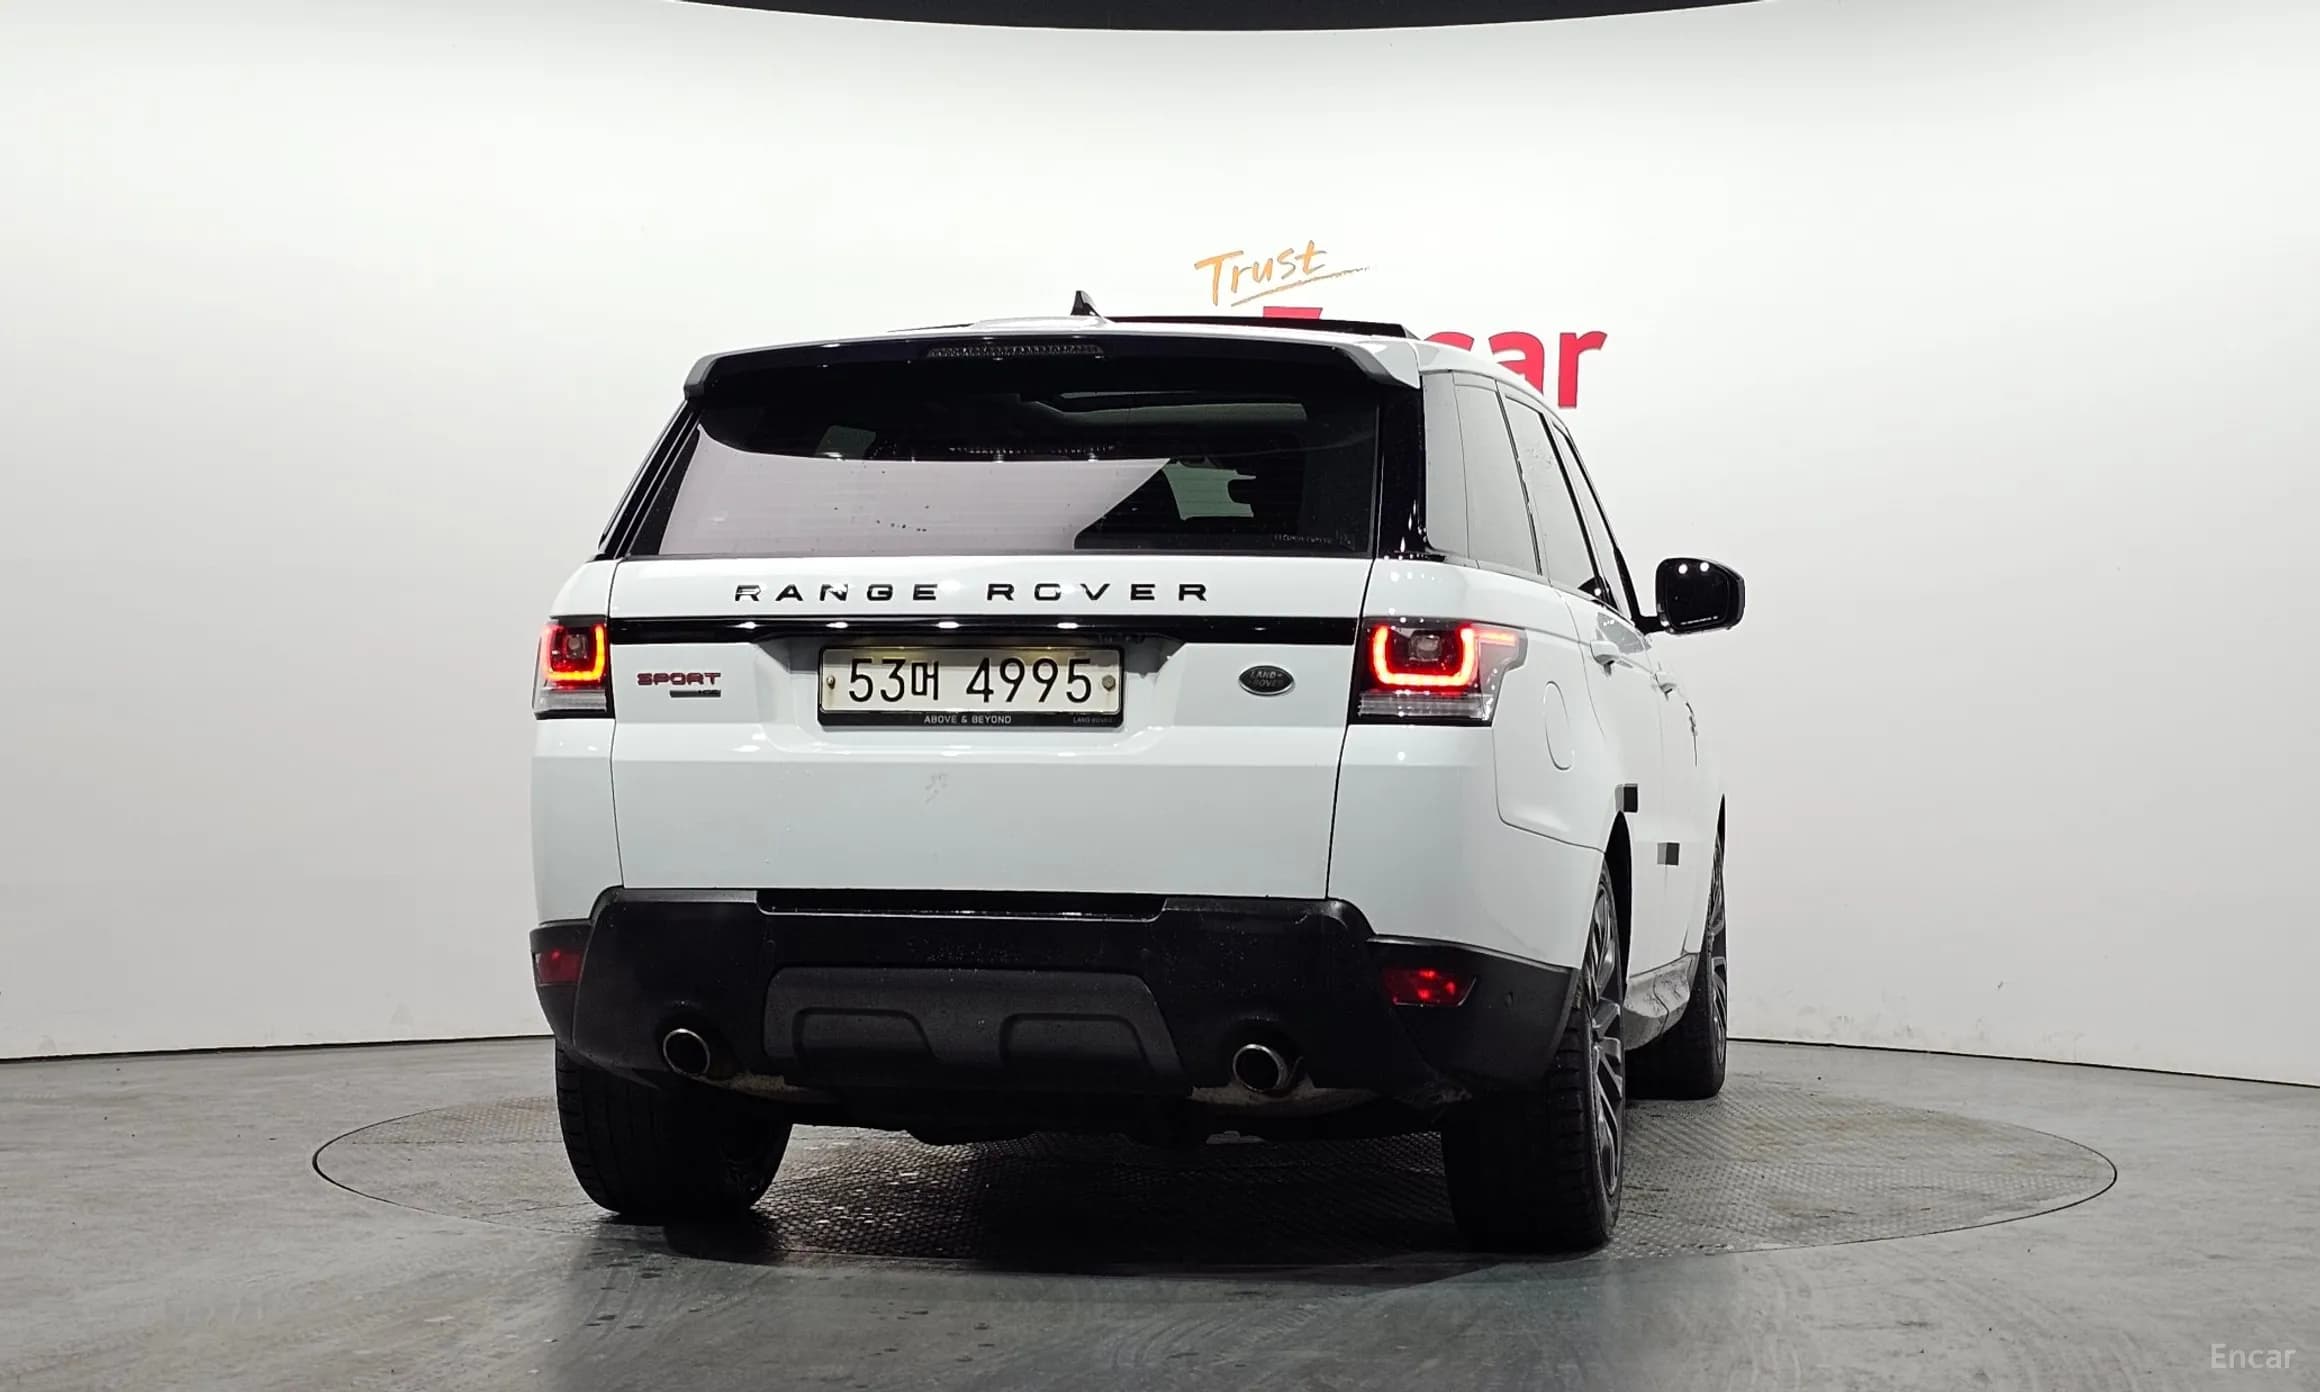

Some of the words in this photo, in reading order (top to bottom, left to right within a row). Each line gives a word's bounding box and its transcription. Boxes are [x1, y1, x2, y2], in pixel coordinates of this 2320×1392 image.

[1194, 240, 1328, 306] Trust
[735, 583, 938, 601] RANGE
[986, 583, 1207, 601] ROVER
[637, 672, 721, 686] SPORT
[848, 657, 939, 702] 53머
[966, 657, 1092, 703] 4995
[923, 715, 957, 724] ABOVE
[960, 715, 968, 724] &
[971, 715, 1012, 724] BEYOND
